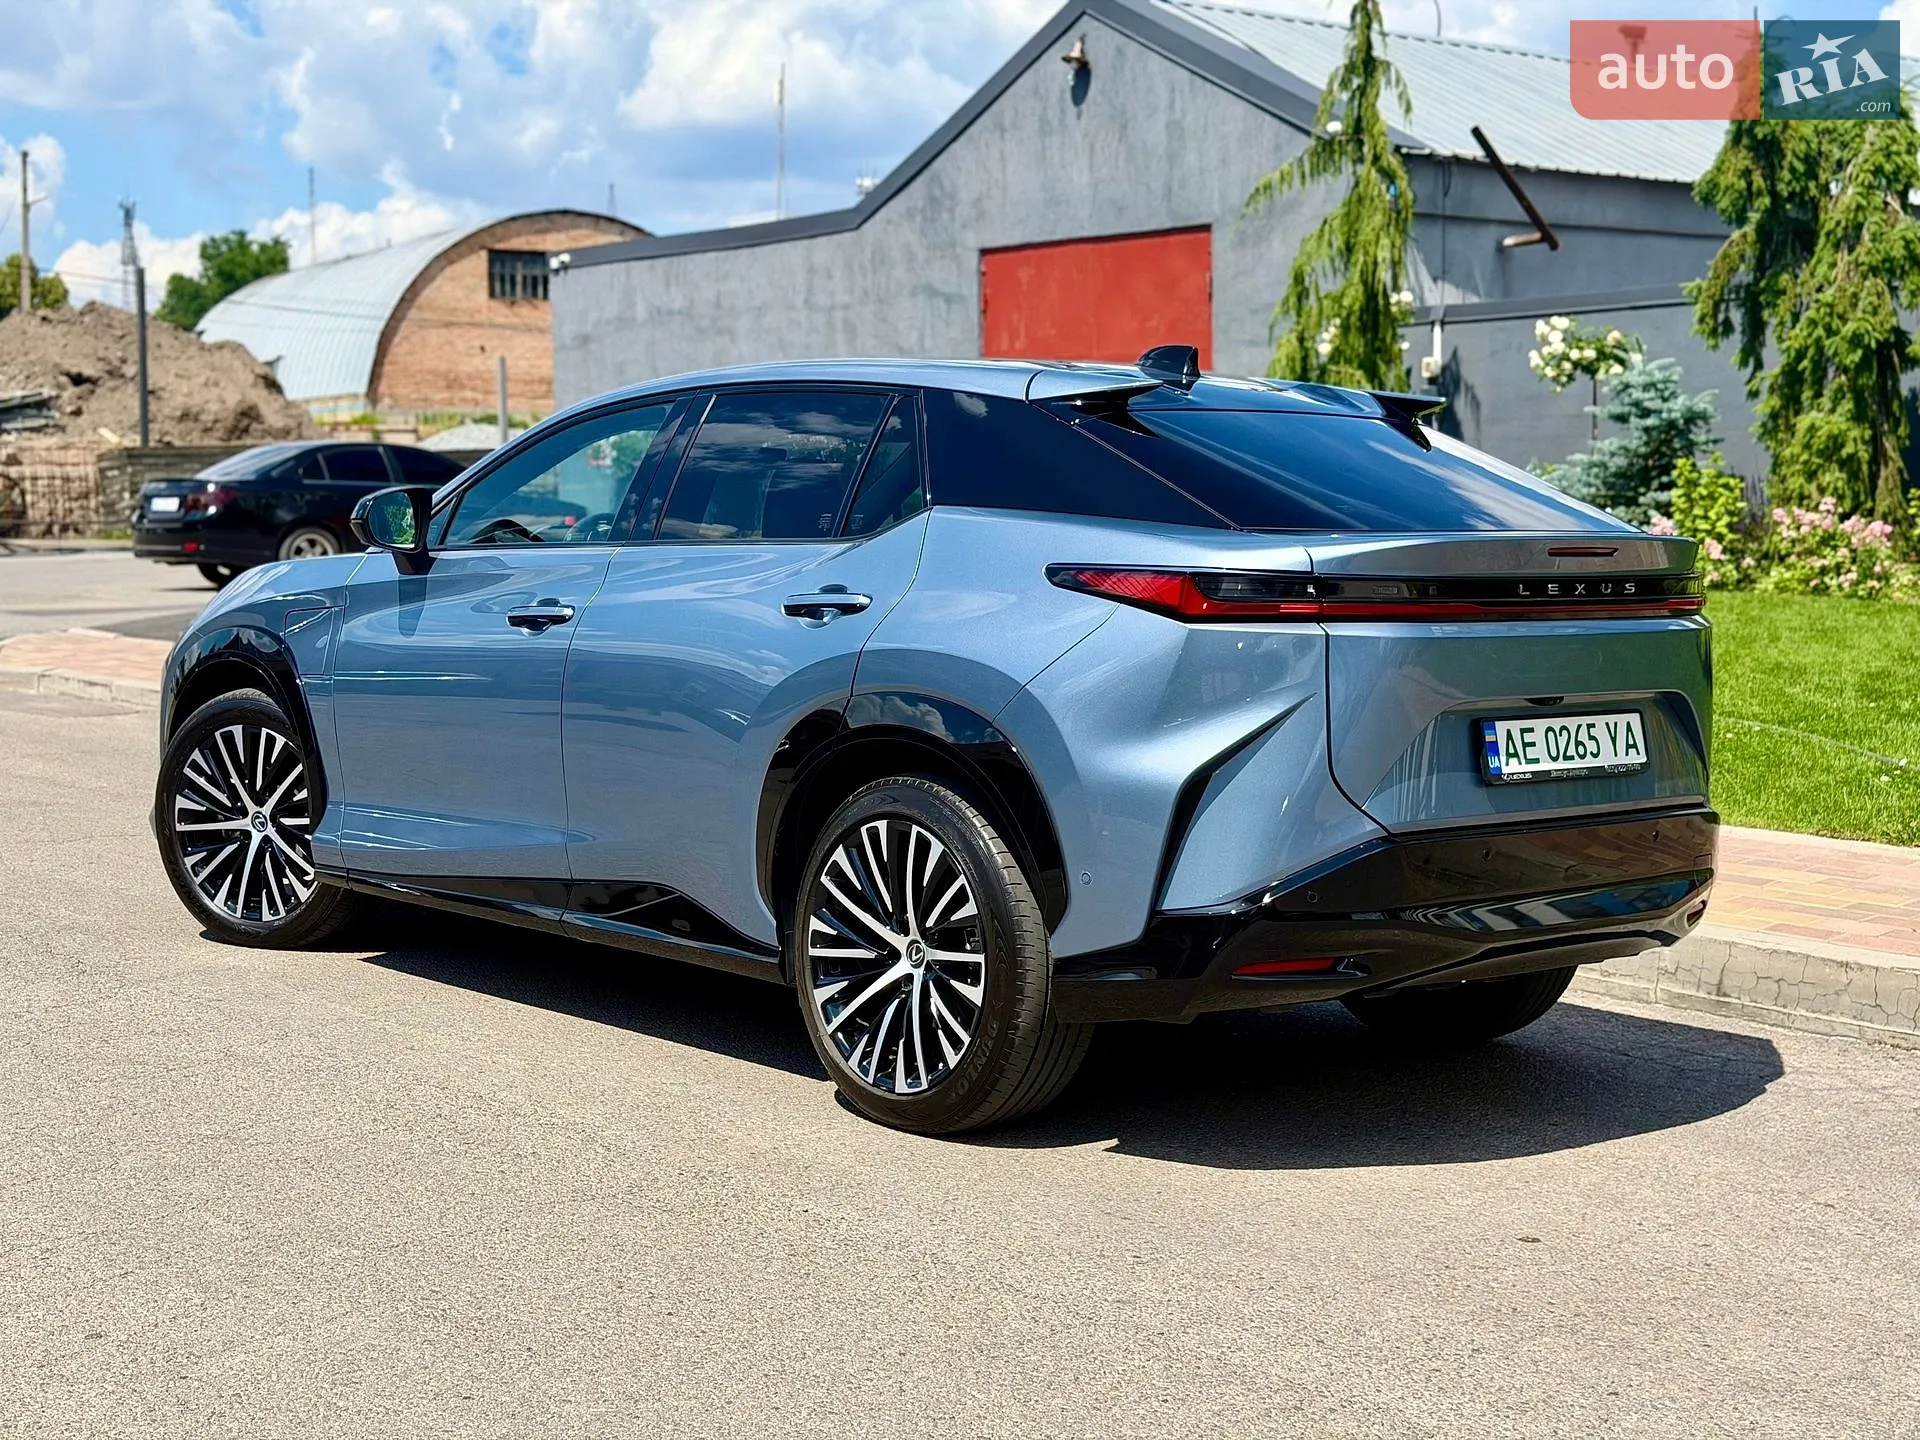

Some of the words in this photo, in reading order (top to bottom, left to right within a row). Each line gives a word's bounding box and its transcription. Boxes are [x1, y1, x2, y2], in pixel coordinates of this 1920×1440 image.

[1518, 583, 1636, 595] LEXUS
[1505, 727, 1540, 766] AE
[1544, 723, 1601, 762] 0265
[1605, 721, 1640, 757] YA
[1488, 756, 1500, 768] UA
